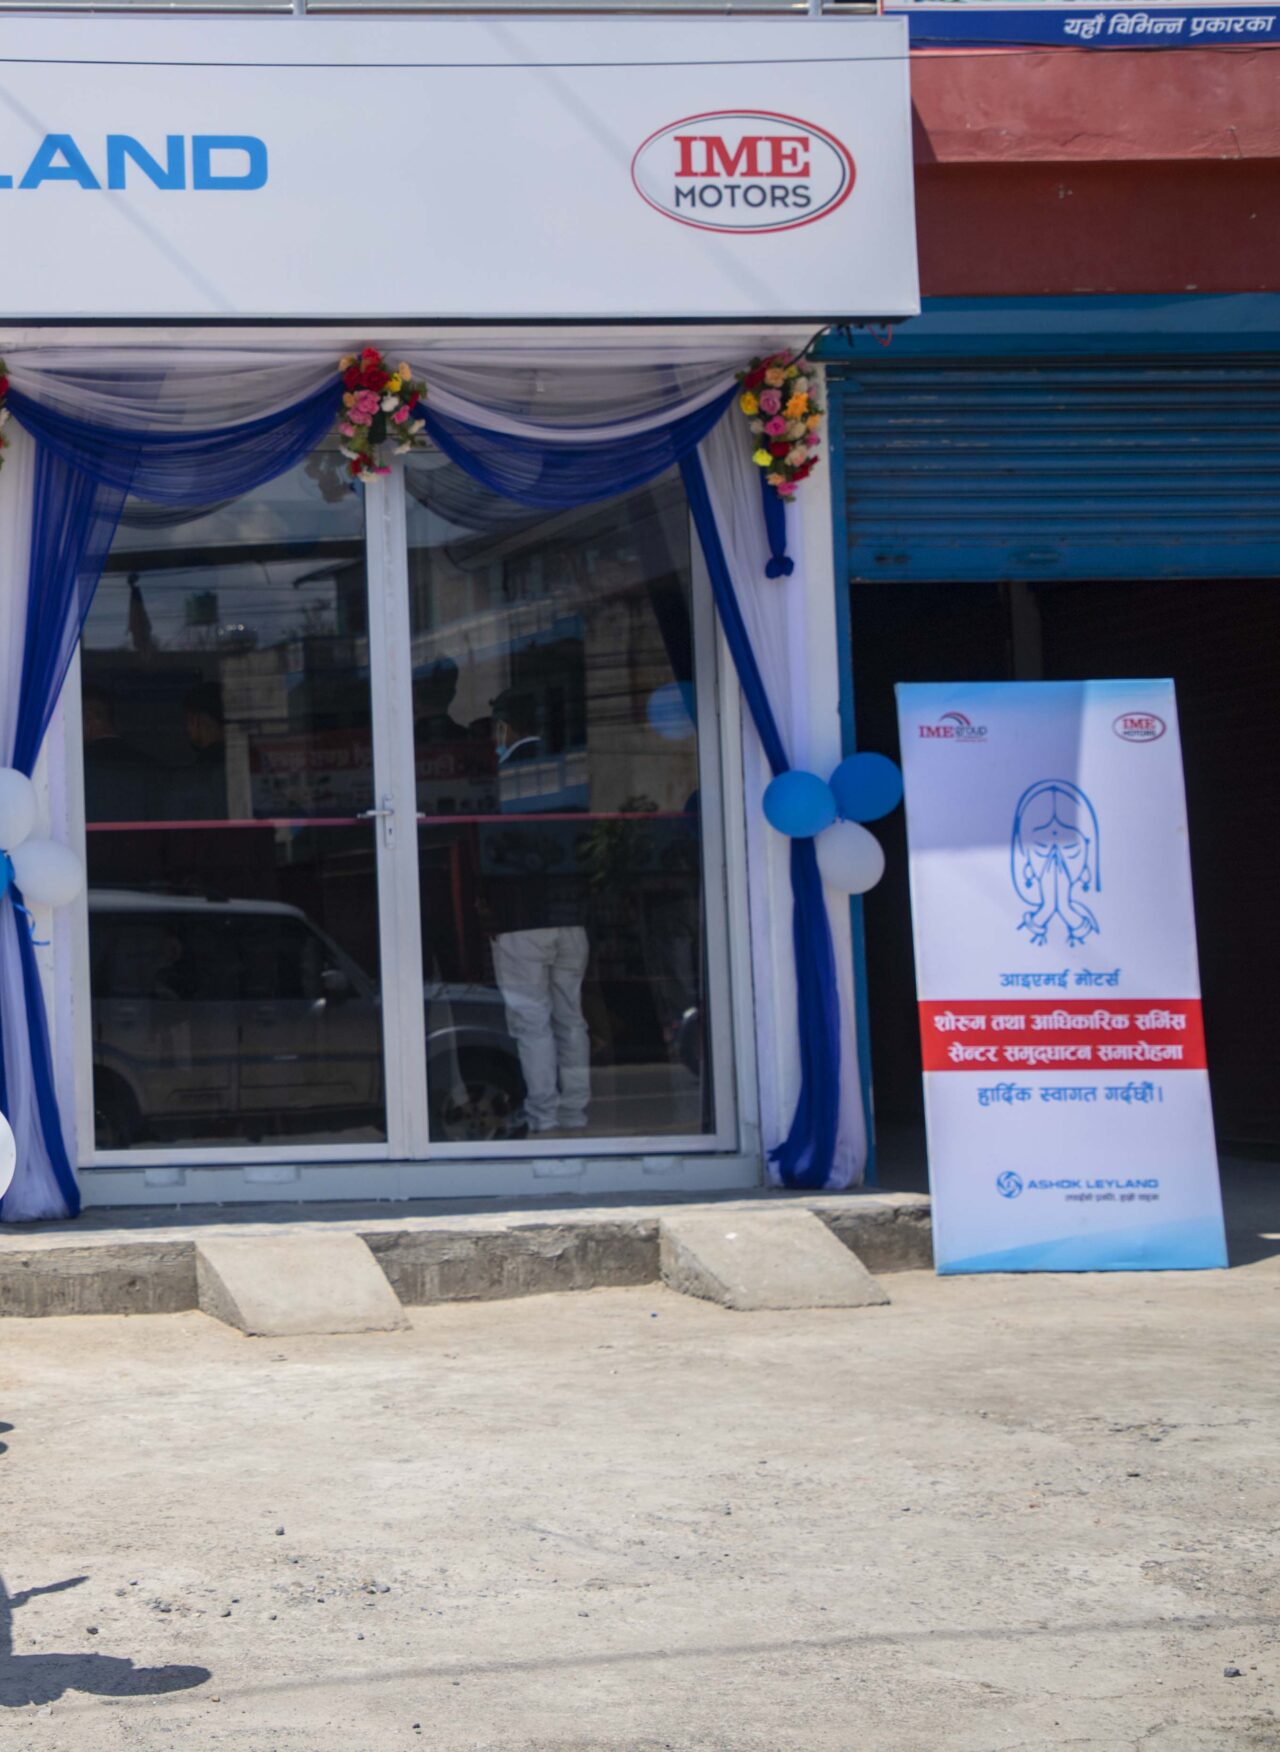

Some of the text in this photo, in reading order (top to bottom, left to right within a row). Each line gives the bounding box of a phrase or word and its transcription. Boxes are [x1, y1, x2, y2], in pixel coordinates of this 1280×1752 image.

[1063, 13, 1276, 39] यहाँ विभिन्न प्रकारका
[673, 136, 811, 178] IME
[674, 184, 812, 208] MOTORS
[1122, 718, 1156, 730] IME
[991, 1014, 1025, 1030] तथा
[1031, 1009, 1129, 1031] आधिकारिक
[948, 1041, 998, 1062] सेन्टर
[977, 1082, 1031, 1106] हार्दिक
[1040, 1086, 1097, 1104] स्वागत
[1027, 1178, 1159, 1190] ASHOK LEYLAND
